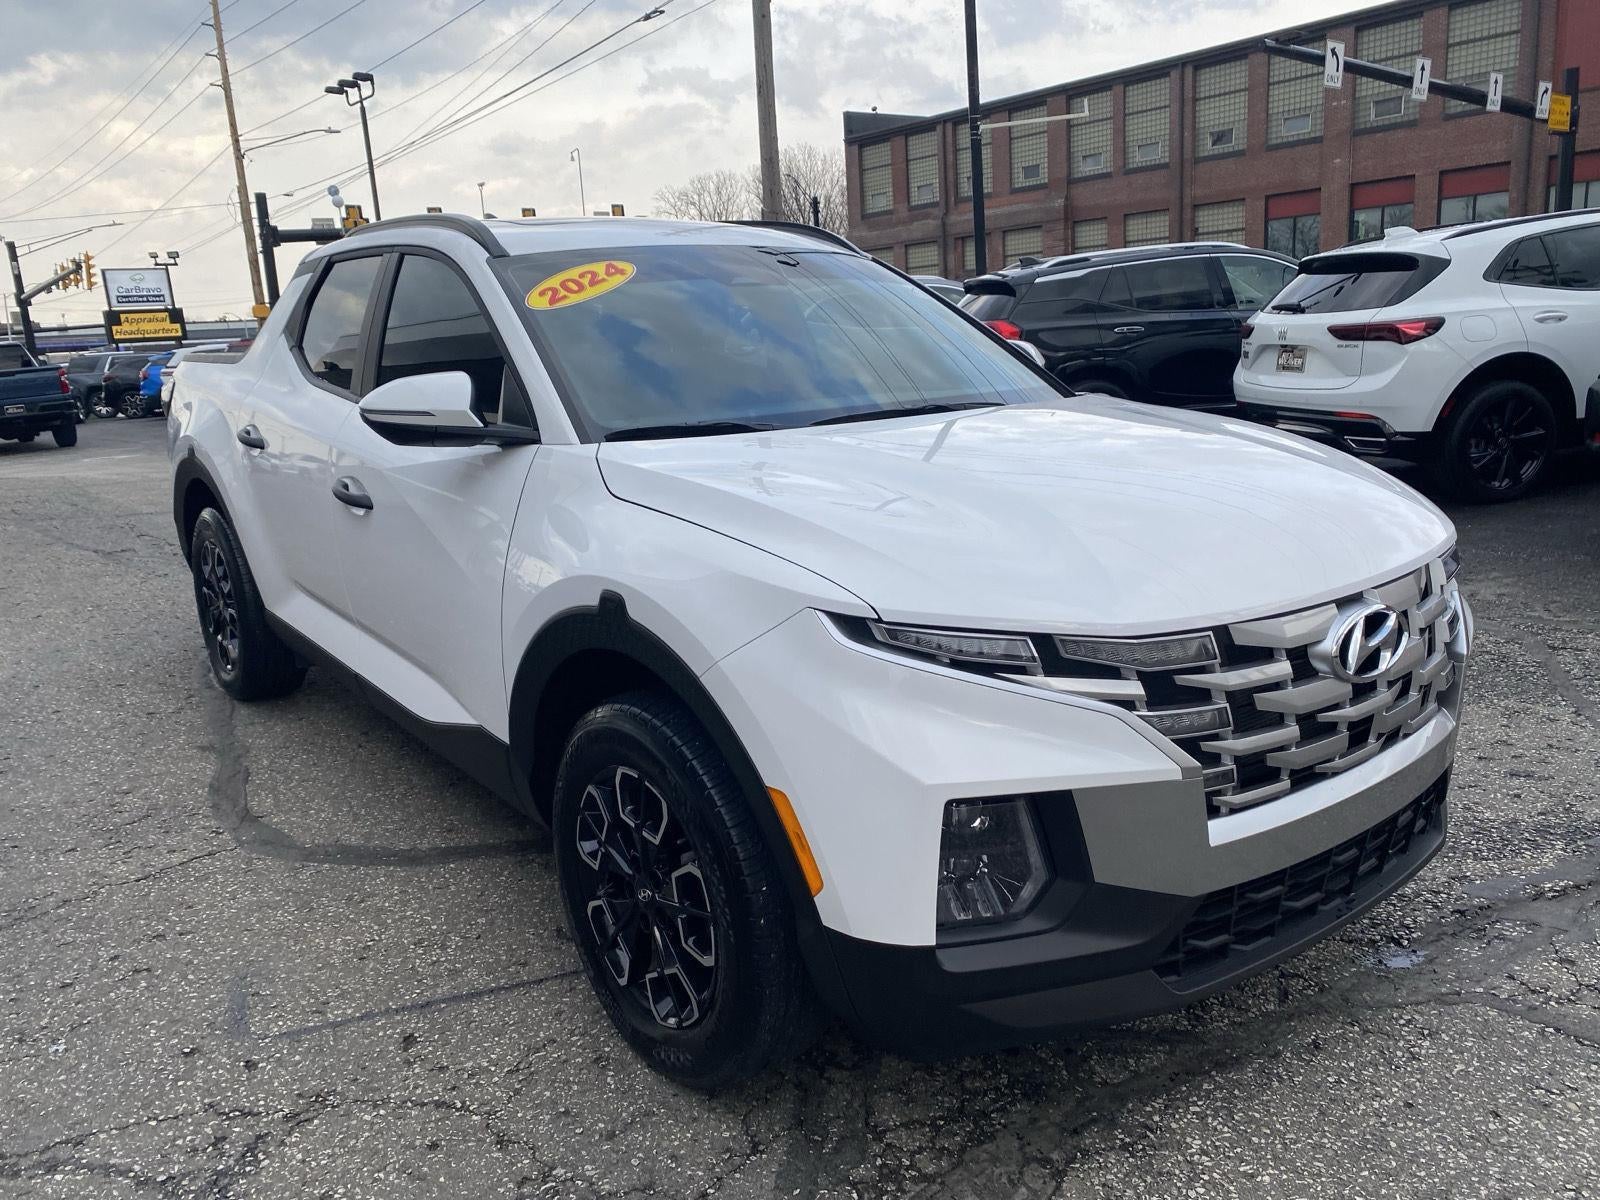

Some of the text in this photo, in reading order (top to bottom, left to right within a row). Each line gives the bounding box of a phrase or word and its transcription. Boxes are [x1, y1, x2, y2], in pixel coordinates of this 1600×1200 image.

[538, 262, 627, 307] 2024
[117, 286, 162, 294] CarBravo
[122, 315, 167, 325] Appraisal
[115, 327, 179, 337] Headquarters
